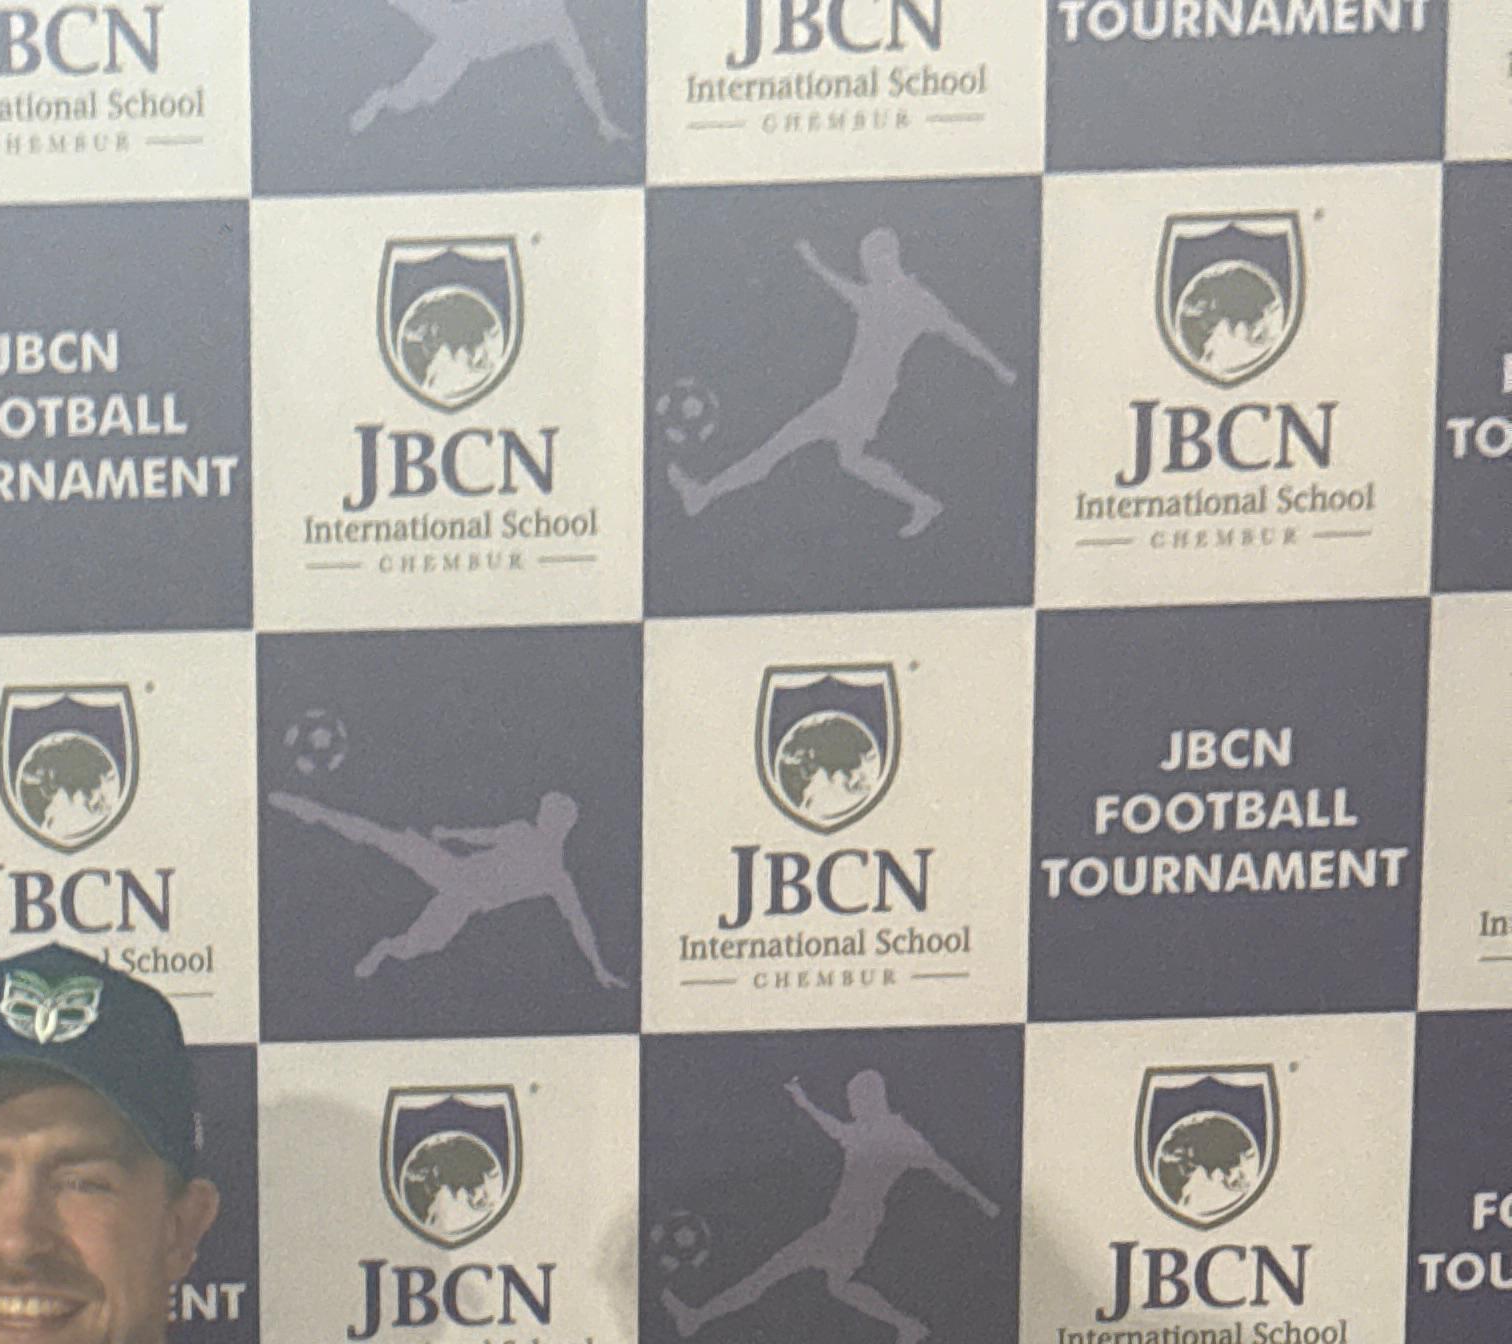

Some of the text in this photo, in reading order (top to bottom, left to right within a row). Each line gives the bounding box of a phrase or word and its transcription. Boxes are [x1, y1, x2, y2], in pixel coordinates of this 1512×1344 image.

[726, 0, 942, 70] JBCN
[1059, 0, 1427, 40] TOURNAMENT
[108, 87, 203, 119] School
[687, 64, 986, 103] International School
[1116, 400, 1338, 488] JBCN
[343, 424, 559, 512] JBCN
[1076, 482, 1375, 520] International School
[305, 507, 598, 544] International School
[1161, 728, 1291, 770] JBCN
[1096, 788, 1357, 834] FOOTBALL
[718, 845, 934, 930] JBCN
[1042, 848, 1408, 897] TOURNAMENT
[121, 944, 213, 974] School
[680, 925, 970, 961] International School
[347, 1259, 556, 1341] JBCN
[1096, 1241, 1311, 1323] JBCN
